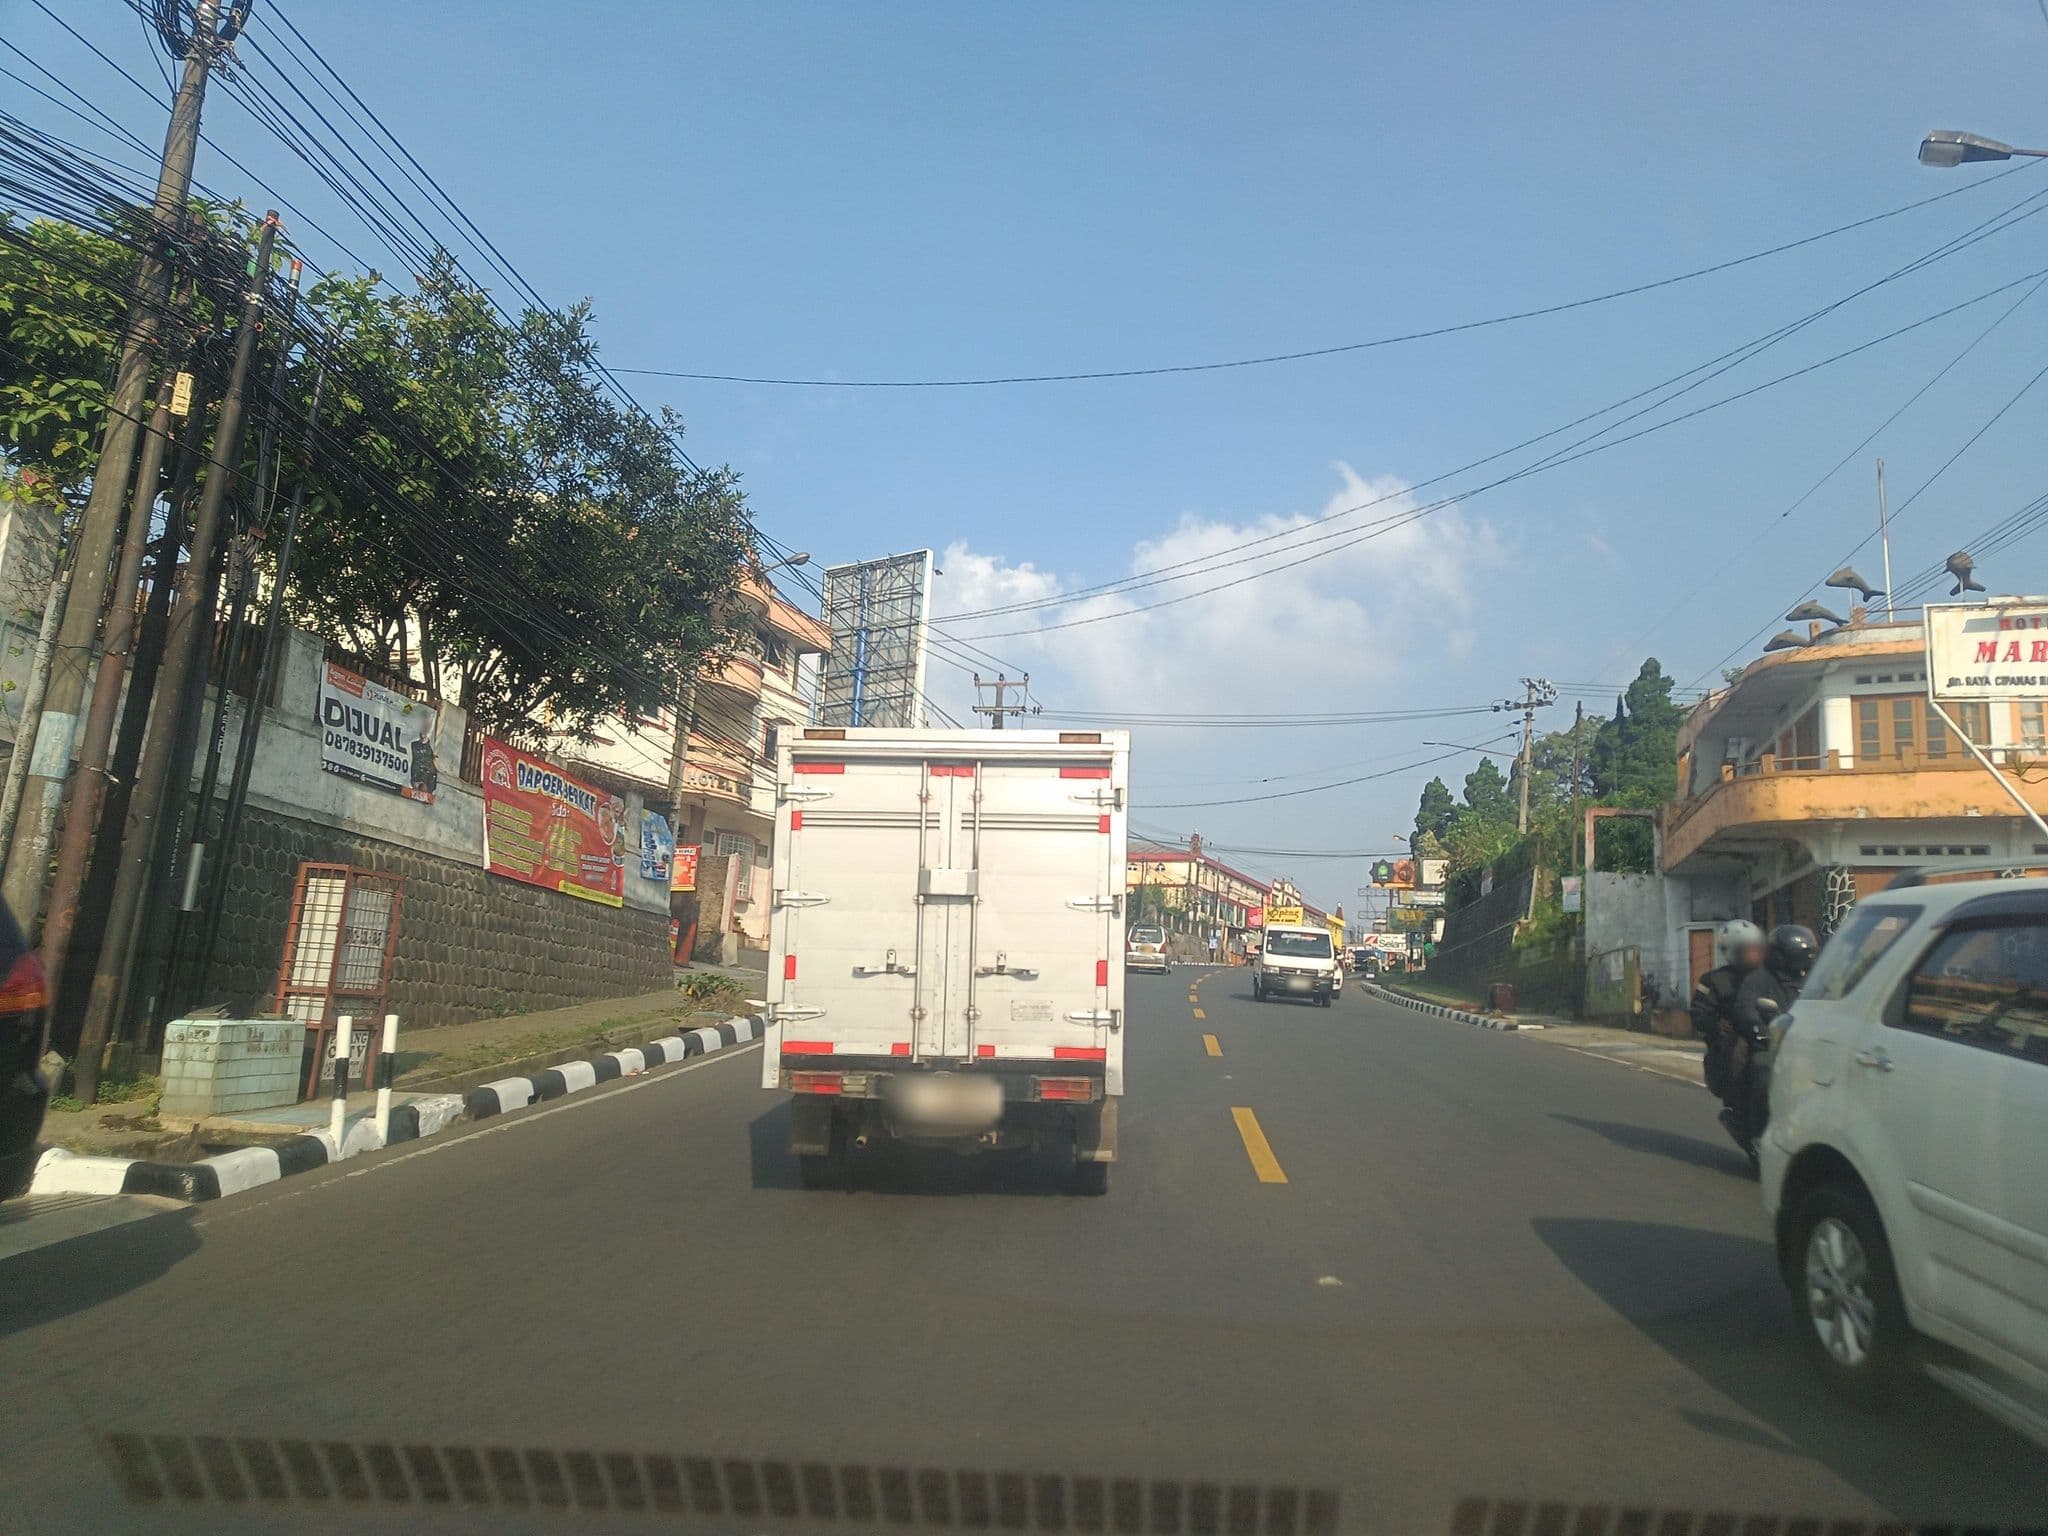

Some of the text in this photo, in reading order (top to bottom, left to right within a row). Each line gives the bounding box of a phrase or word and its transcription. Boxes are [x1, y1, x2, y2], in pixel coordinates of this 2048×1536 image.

[1998, 616, 2048, 631] HOT
[1966, 676, 1991, 687] RAYA
[1995, 675, 2037, 687] CIPANAS
[325, 696, 408, 754] DIJUAL
[325, 731, 409, 774] 087839137500
[518, 762, 563, 796] DAPOER
